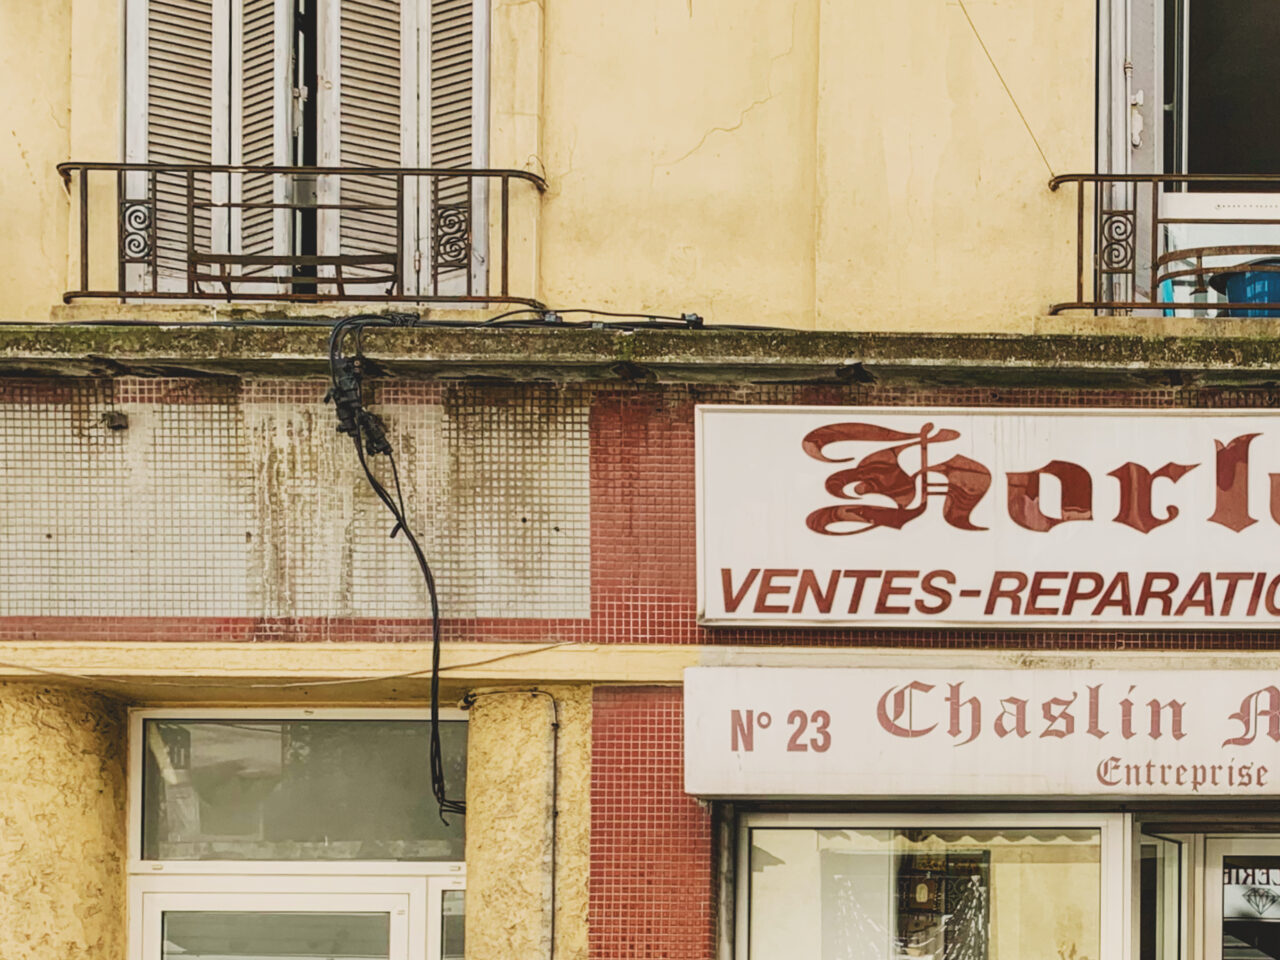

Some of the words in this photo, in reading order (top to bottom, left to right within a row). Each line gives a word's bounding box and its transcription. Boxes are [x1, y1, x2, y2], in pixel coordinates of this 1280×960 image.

[787, 710, 831, 753] 23
[877, 680, 1187, 747] Chaslin
[1096, 757, 1268, 792] Entreprise
